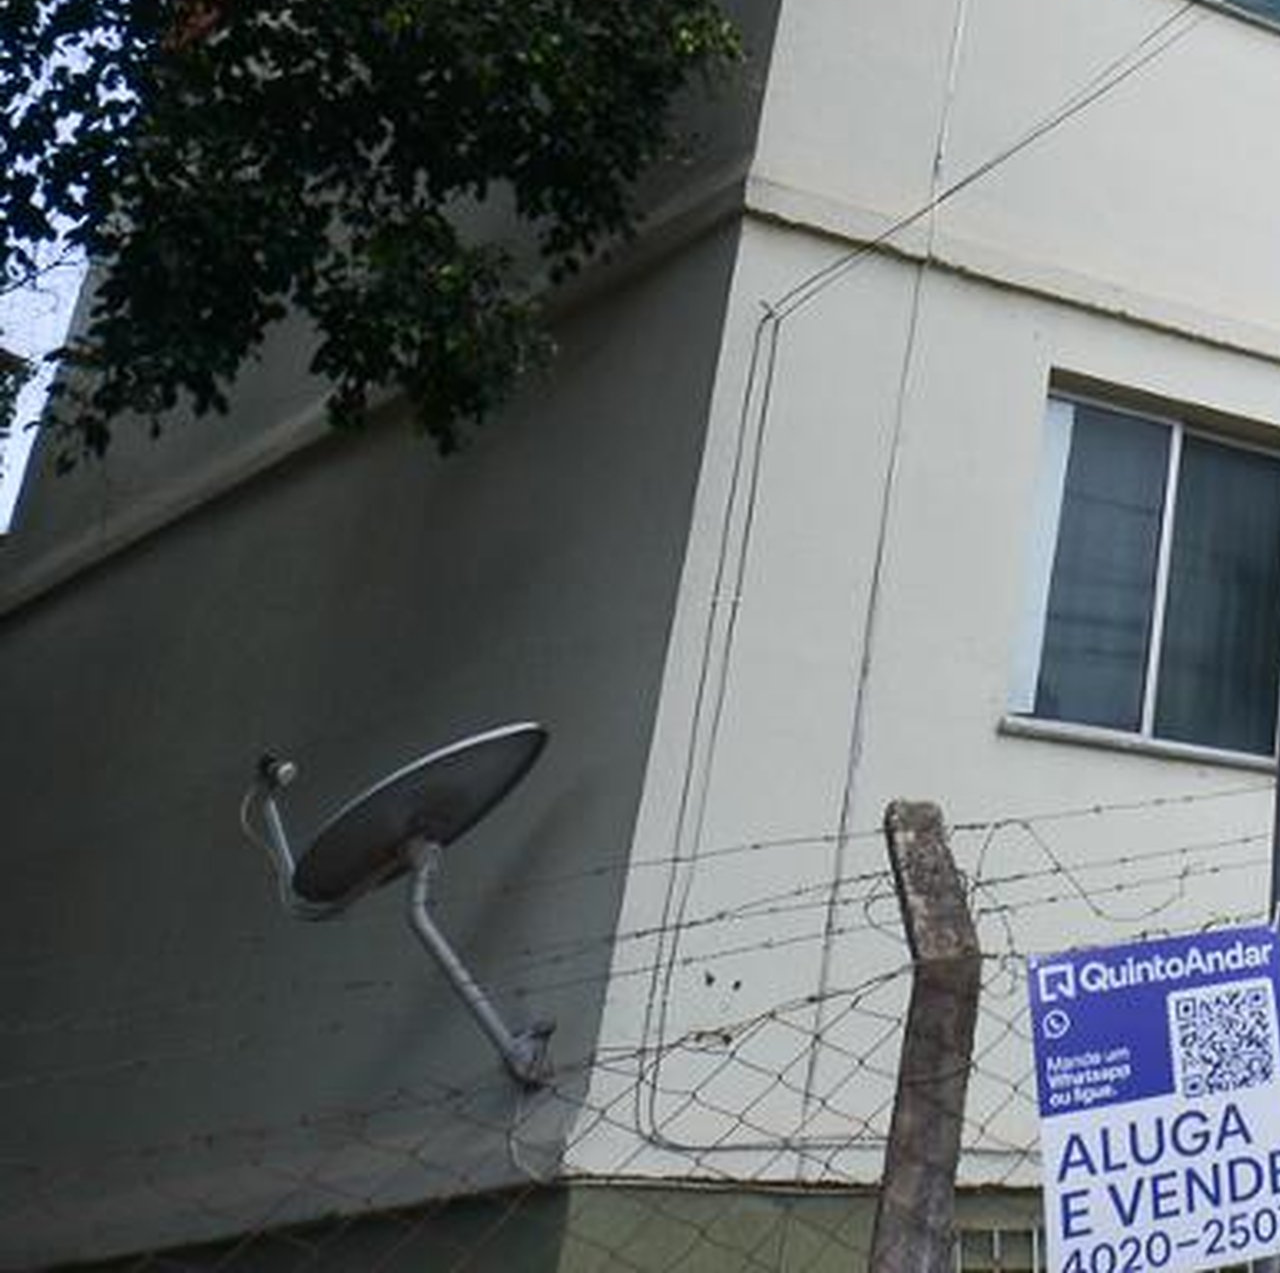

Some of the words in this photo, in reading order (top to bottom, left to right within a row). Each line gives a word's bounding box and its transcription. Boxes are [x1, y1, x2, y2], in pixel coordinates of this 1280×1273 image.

[1079, 941, 1273, 992] QuintoAndar
[1049, 1091, 1071, 1107] ou
[1058, 1103, 1253, 1183] ALUGA
[1061, 1189, 1093, 1240] E
